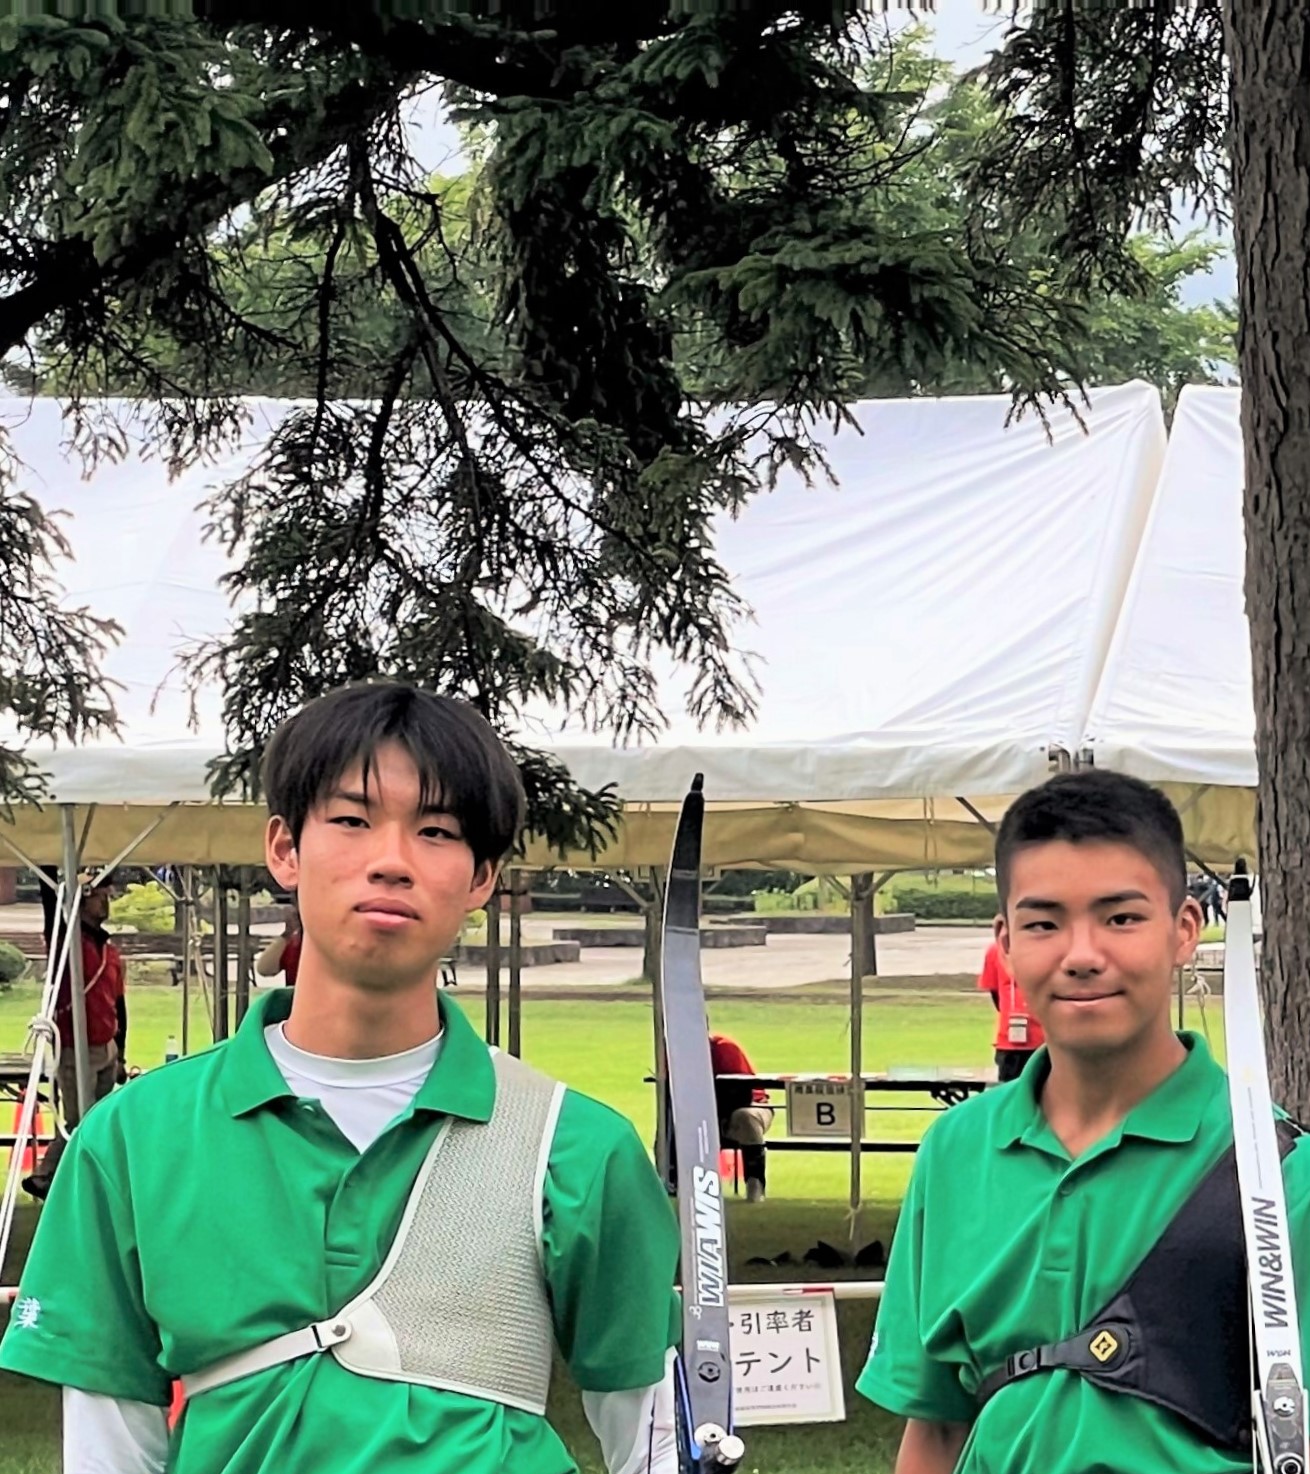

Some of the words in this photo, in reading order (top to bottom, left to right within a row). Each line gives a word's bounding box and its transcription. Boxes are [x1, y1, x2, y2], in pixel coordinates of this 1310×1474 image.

[816, 1102, 836, 1126] B
[693, 1165, 724, 1307] WIAWIS
[1251, 1196, 1288, 1329] WIN&WIN
[735, 1347, 820, 1377] テント
